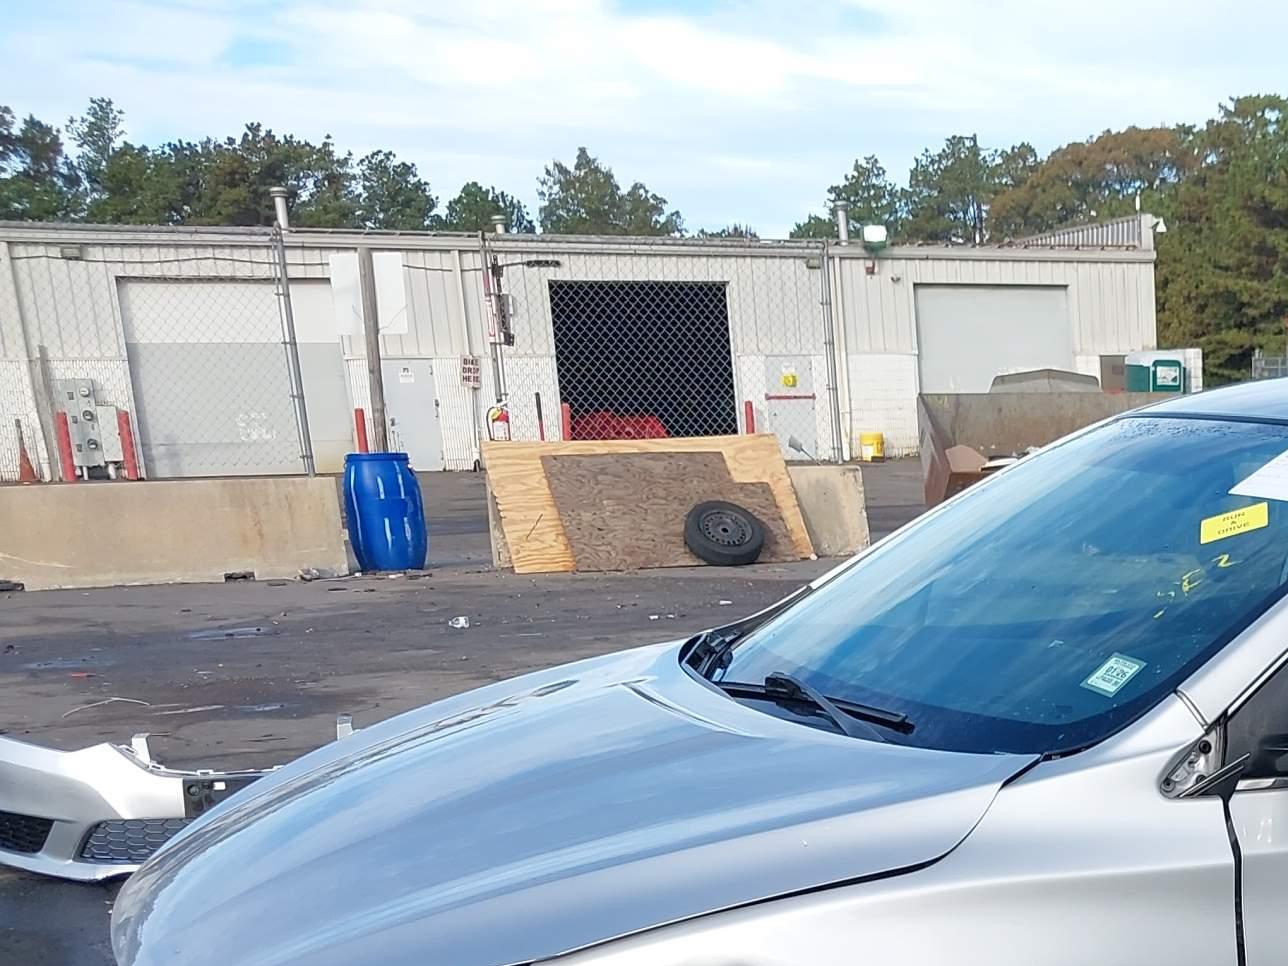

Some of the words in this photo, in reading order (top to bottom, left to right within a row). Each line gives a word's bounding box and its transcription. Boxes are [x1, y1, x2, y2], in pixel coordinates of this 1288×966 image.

[463, 358, 479, 366] BIKE
[462, 367, 480, 375] DROP
[462, 375, 480, 383] HERE
[1217, 521, 1250, 535] DRIVE
